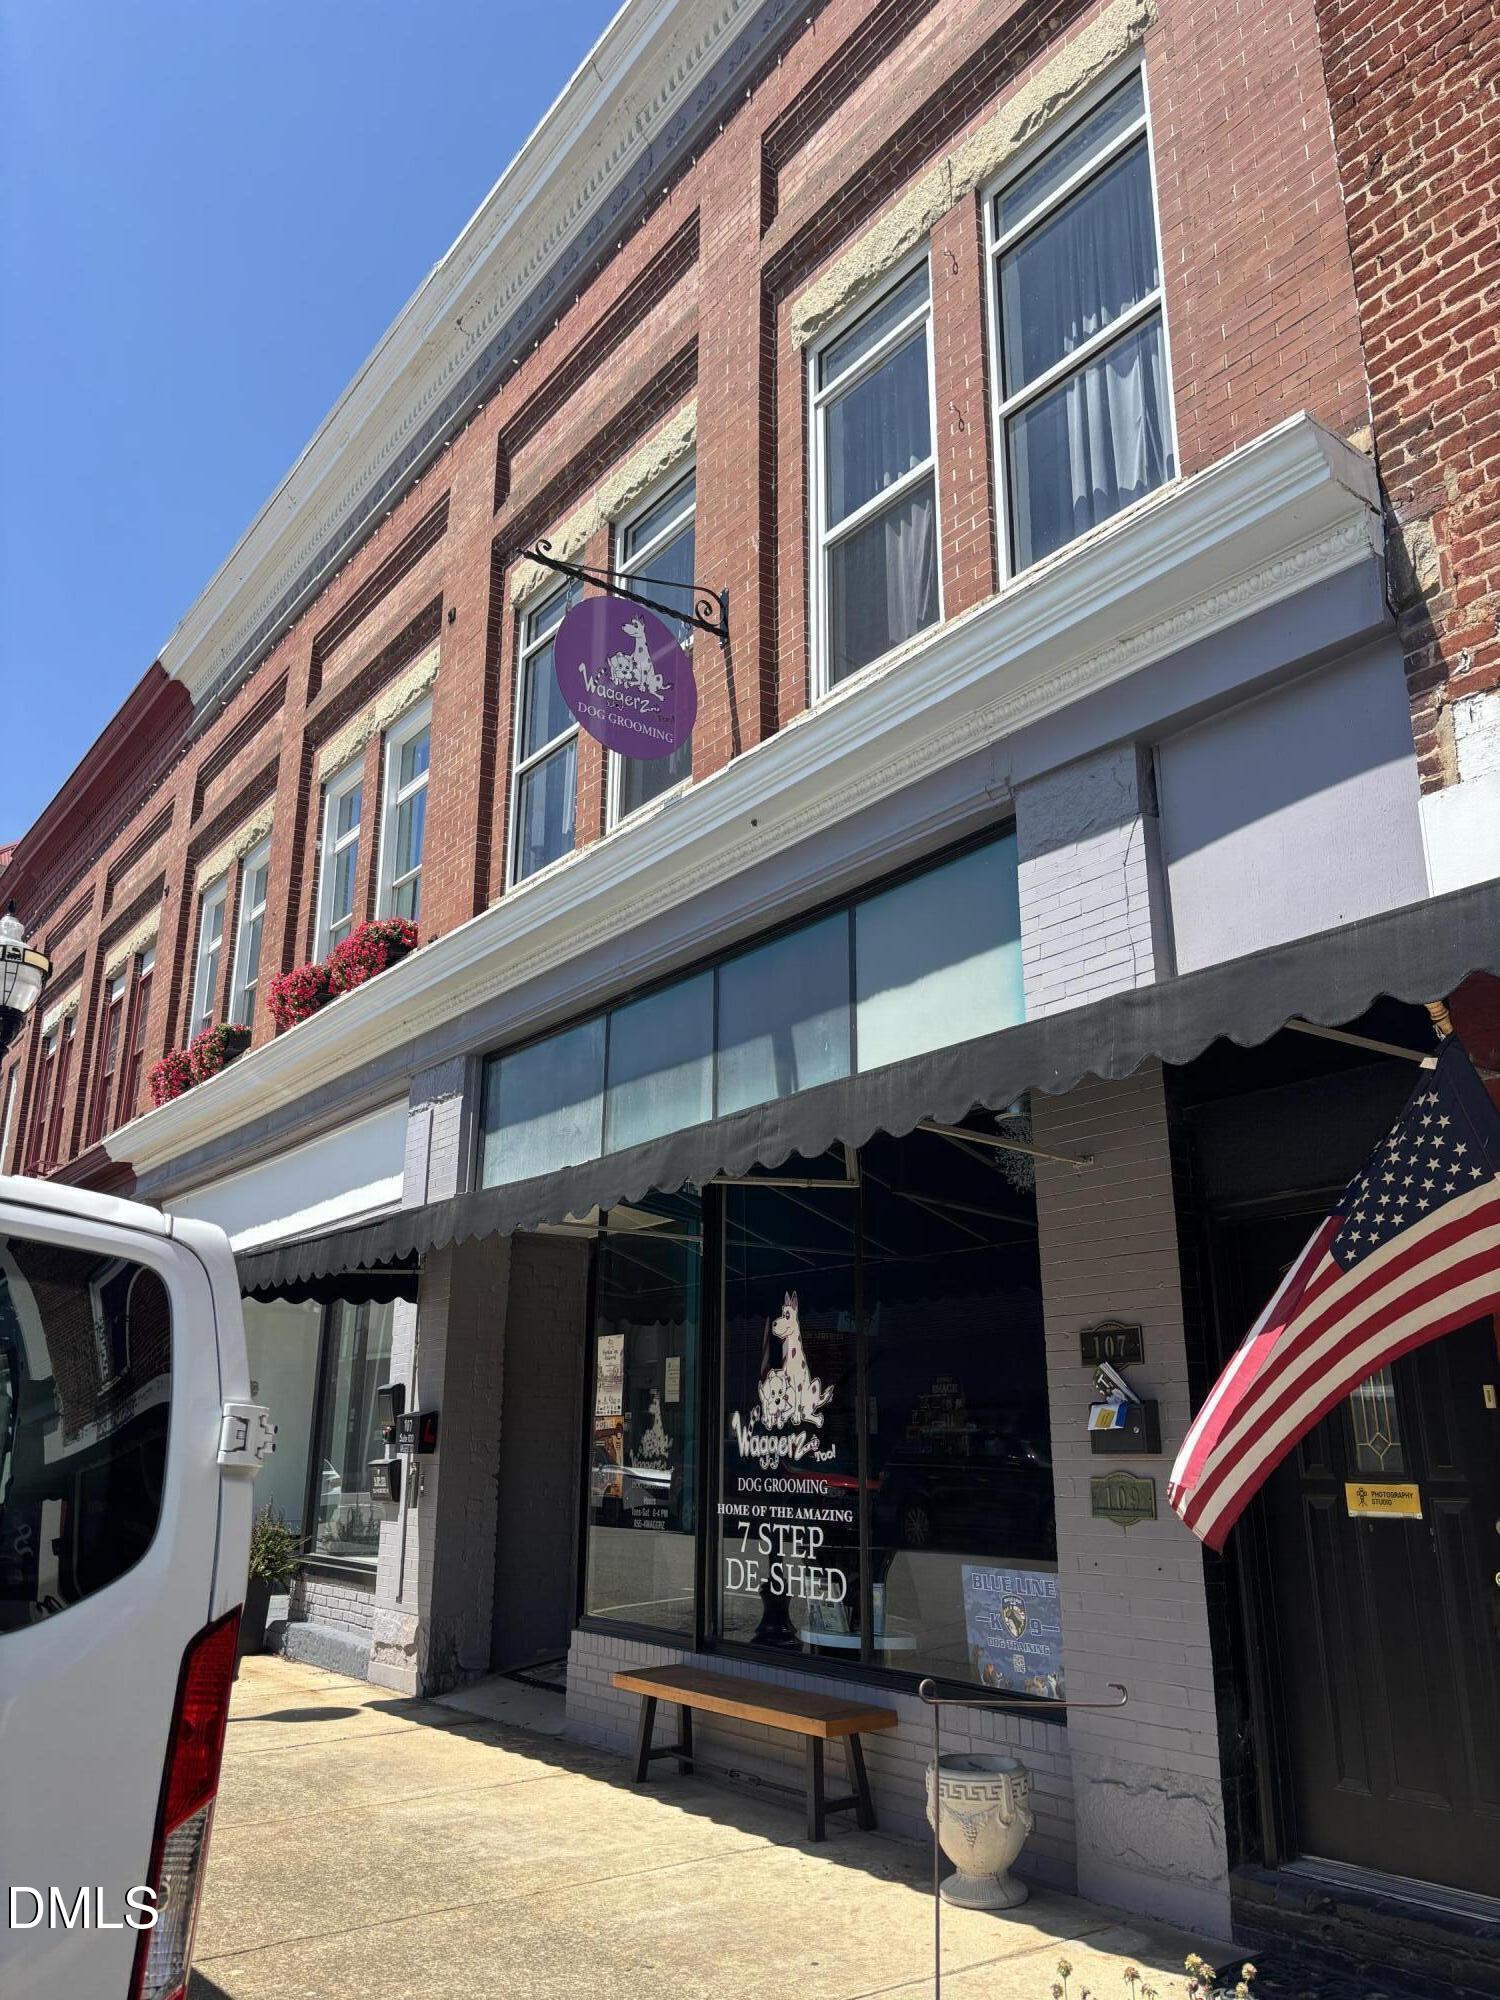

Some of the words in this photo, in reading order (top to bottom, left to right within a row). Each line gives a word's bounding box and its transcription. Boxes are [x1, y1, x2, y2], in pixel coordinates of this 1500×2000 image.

[577, 701, 606, 721] DOG
[608, 713, 675, 744] GROOMING
[1093, 1334, 1127, 1359] 107
[737, 1477, 762, 1493] DOG
[763, 1477, 829, 1495] GROOMING
[1105, 1486, 1140, 1509] 109
[1371, 1491, 1414, 1500] PHOTOGRAPHY
[716, 1503, 750, 1516] HOME
[751, 1504, 768, 1517] OF
[769, 1506, 794, 1519] THE
[795, 1507, 854, 1523] AMAZING
[1371, 1498, 1393, 1506] STUDIO
[737, 1521, 750, 1554] 7
[757, 1522, 825, 1560] STEP
[725, 1557, 848, 1603] DE-SHED
[971, 1572, 1012, 1594] BLUE
[1015, 1577, 1057, 1598] LINE
[987, 1636, 1005, 1649] DOG
[1006, 1639, 1051, 1656] TRAINING
